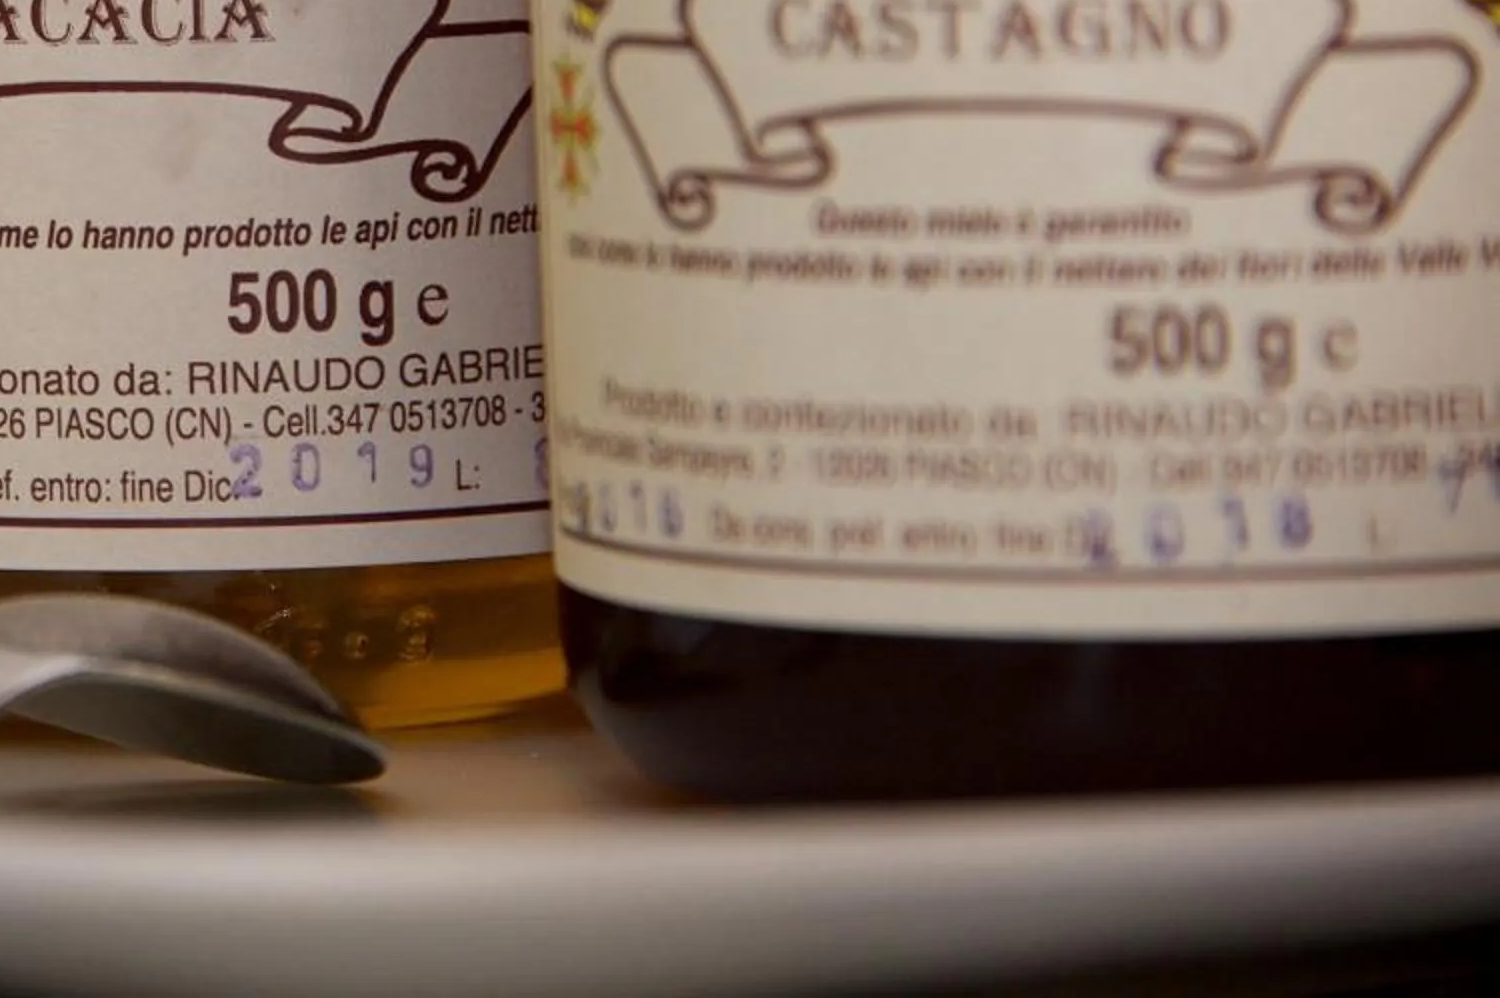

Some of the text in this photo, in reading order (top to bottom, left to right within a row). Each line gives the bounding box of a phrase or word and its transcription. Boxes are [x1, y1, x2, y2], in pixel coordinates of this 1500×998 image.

[46, 218, 74, 250] lo
[82, 219, 175, 250] hanno
[182, 215, 312, 258] prodotto
[320, 214, 348, 246] le
[354, 211, 400, 251] api
[406, 214, 459, 242] con
[465, 206, 483, 238] il
[227, 267, 338, 335] 500
[358, 279, 395, 347] g
[1109, 304, 1230, 377] 500
[1253, 316, 1295, 391] g
[113, 362, 173, 396] da:
[188, 355, 385, 395] RINAUDO
[35, 406, 155, 441] PIASCO
[164, 406, 232, 448] (CN)
[390, 393, 507, 434] 0513708
[30, 472, 112, 502] entro:
[121, 469, 174, 502] fine
[455, 458, 481, 491] L:
